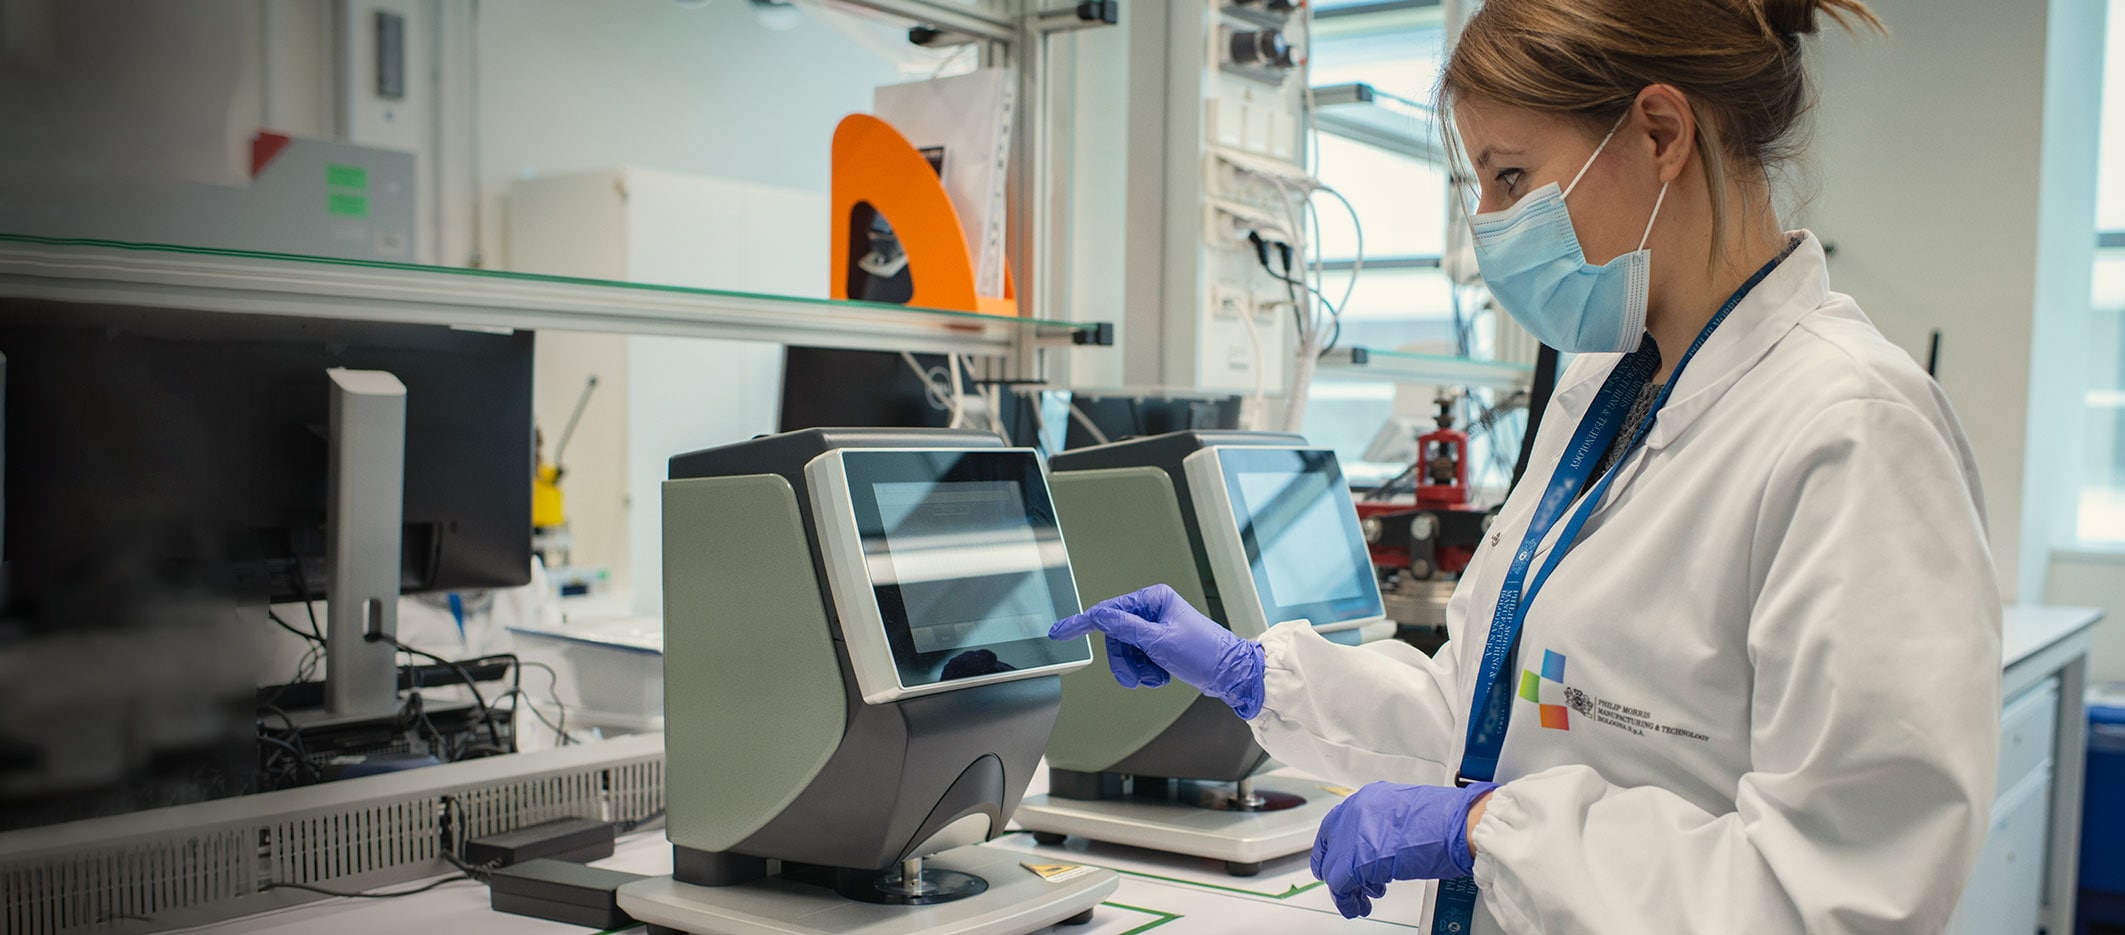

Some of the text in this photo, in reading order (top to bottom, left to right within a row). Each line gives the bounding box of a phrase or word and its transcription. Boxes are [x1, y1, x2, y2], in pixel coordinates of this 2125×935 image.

[1602, 408, 1610, 416] &
[1569, 415, 1608, 470] TECHNOLOGY
[1492, 590, 1507, 633] BOLOGNA
[1505, 589, 1519, 623] PHILIP
[1491, 590, 1512, 670] MANUFACTURING
[1489, 671, 1497, 679] &
[1597, 716, 1626, 730] BOLOGNA
[1598, 699, 1651, 719] PHILIP MORRIS
[1598, 708, 1654, 729] MANUFACTURING
[1662, 725, 1710, 742] TECHNOLOGY
